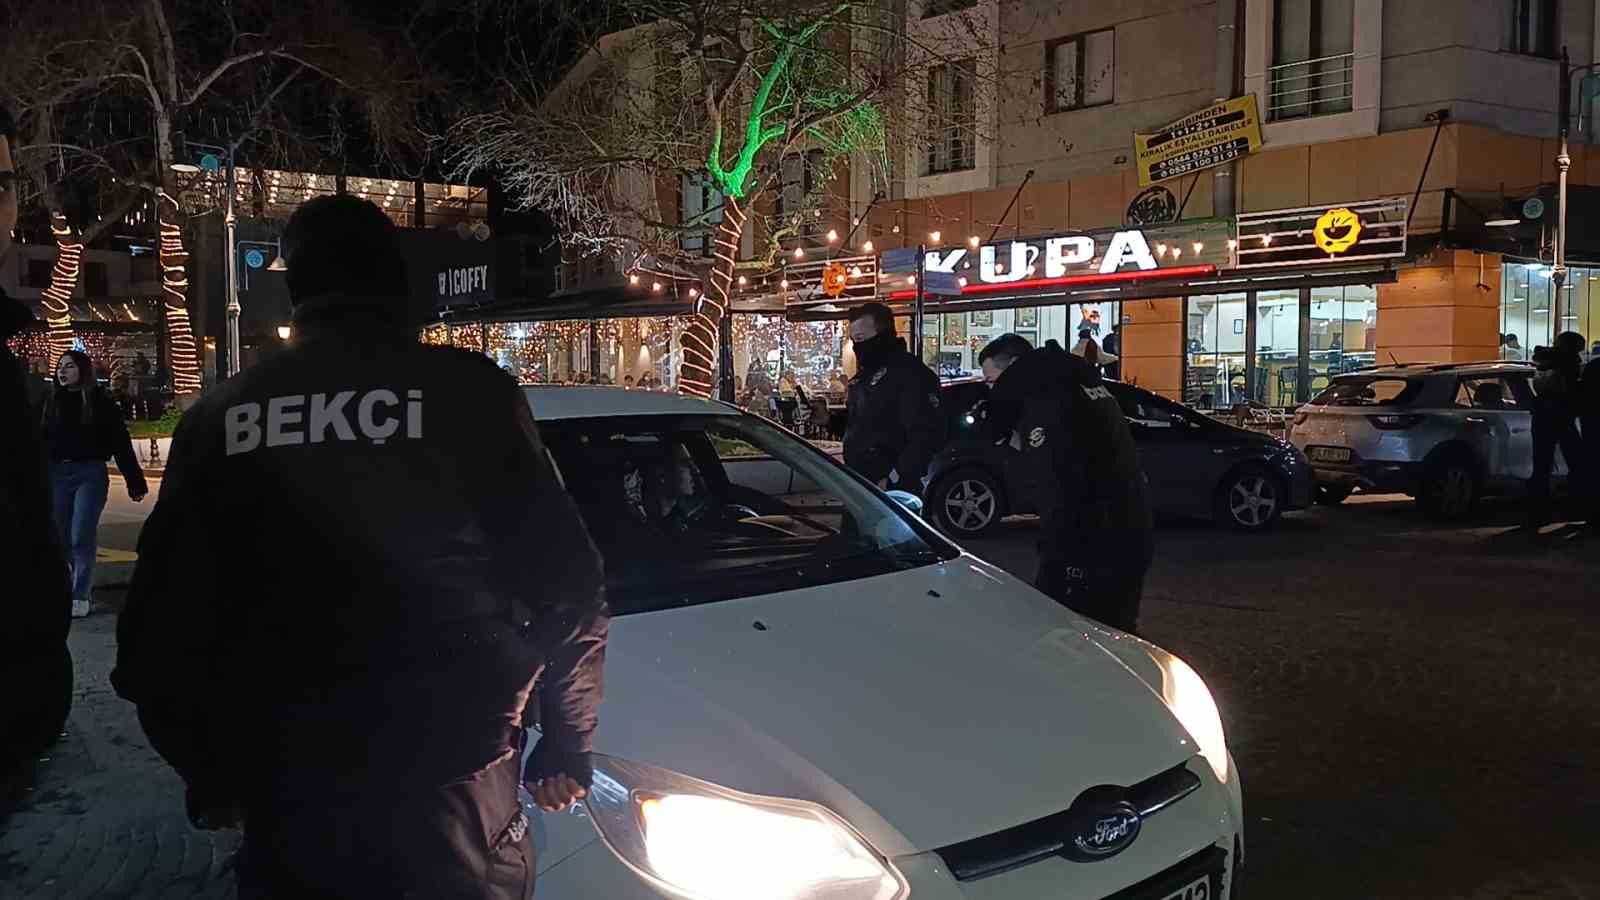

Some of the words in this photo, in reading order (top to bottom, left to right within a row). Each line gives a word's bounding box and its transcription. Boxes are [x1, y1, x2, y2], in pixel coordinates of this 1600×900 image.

[925, 229, 1158, 284] KUPA
[454, 265, 488, 295] COFFY
[1094, 816, 1129, 845] Ford
